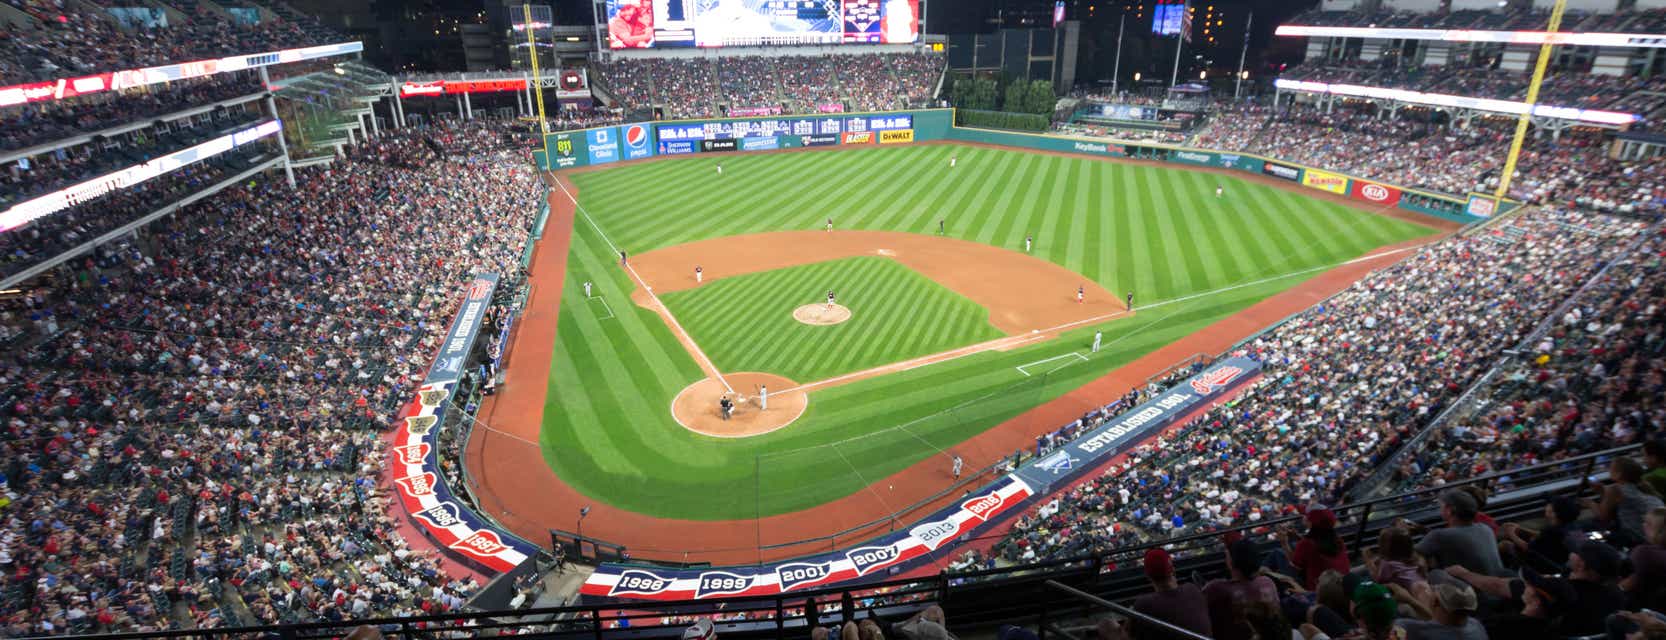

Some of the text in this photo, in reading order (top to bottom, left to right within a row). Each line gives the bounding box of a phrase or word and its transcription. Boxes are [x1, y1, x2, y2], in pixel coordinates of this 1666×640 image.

[1367, 187, 1384, 197] KIA
[1078, 406, 1164, 453] ESTABLISHED
[918, 520, 956, 543] 2013
[465, 532, 500, 553] 1997
[854, 546, 896, 567] 2007
[782, 564, 827, 582] 2001
[619, 575, 664, 591] 1998
[701, 576, 746, 590] 1999
